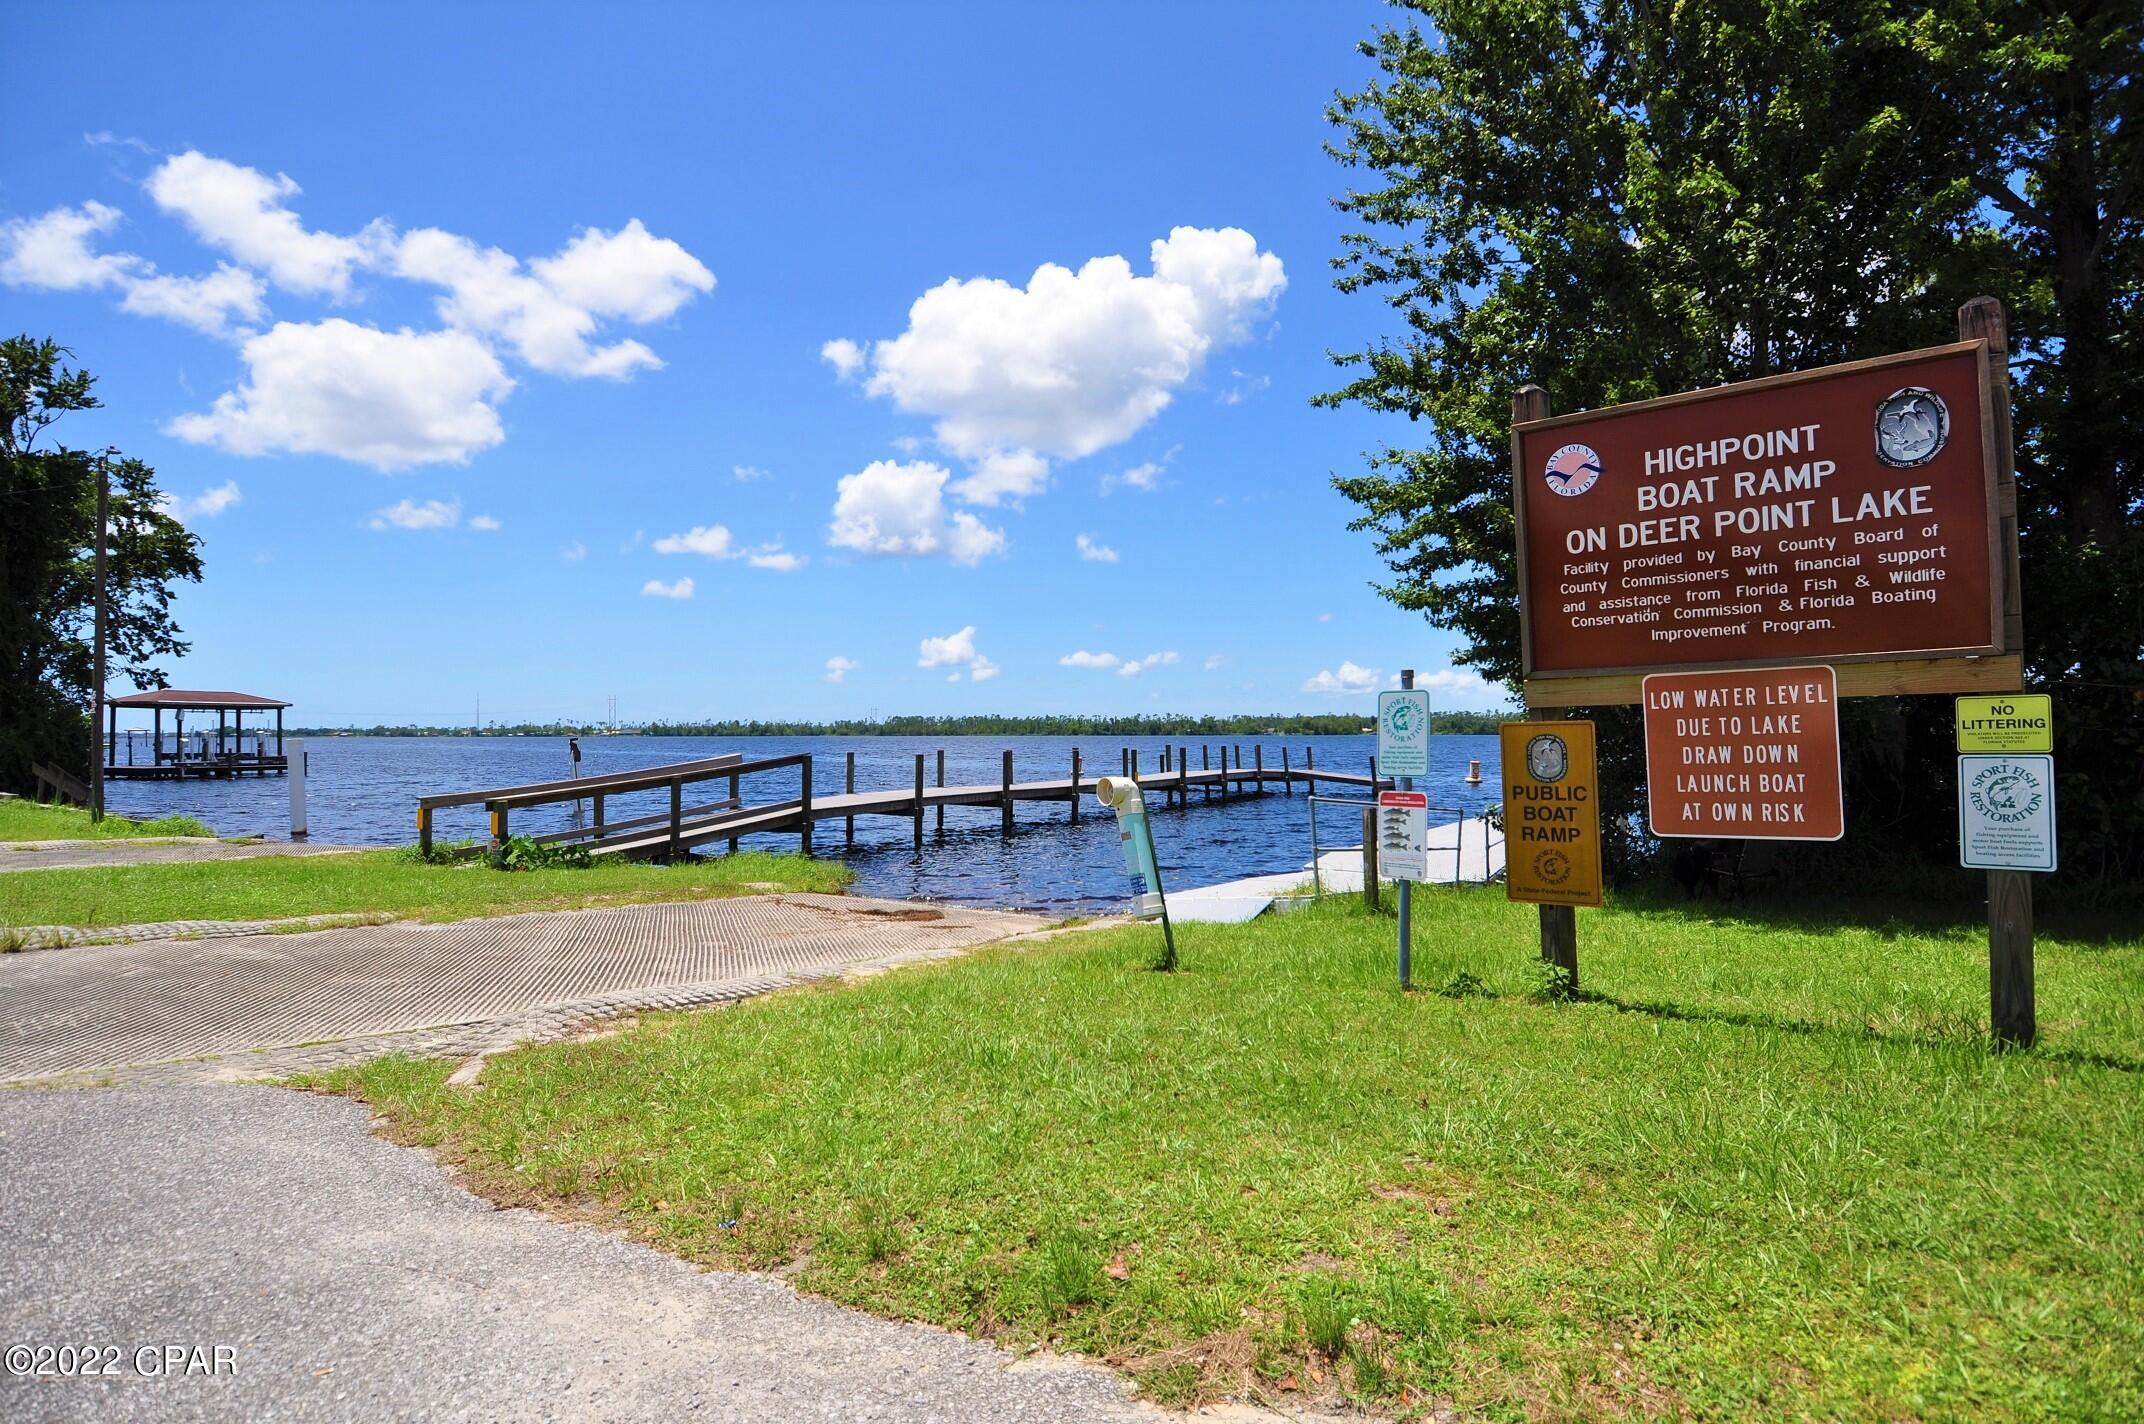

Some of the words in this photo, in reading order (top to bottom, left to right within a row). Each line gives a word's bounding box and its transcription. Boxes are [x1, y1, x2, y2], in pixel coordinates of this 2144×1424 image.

[1547, 455, 1559, 470] BAY
[1561, 445, 1597, 464] COUNTY
[1644, 424, 1821, 476] HIGHPOINT
[1548, 475, 1597, 496] FLORIDA
[1637, 476, 1720, 512] BOAT
[1734, 460, 1836, 499] RAMP
[1566, 527, 1606, 555] ON
[1618, 515, 1701, 549] DEER
[1714, 500, 1815, 537] POINT
[1831, 485, 1934, 524] LAKE
[1563, 562, 1609, 576] Facility
[1623, 552, 1683, 572] provided
[1697, 550, 1716, 564] by
[1731, 545, 1762, 559] Bay
[1778, 537, 1837, 553] County
[1854, 528, 1904, 545] Board
[1921, 523, 1939, 537] of
[1560, 580, 1608, 595] County
[1621, 568, 1729, 589] Commissioners
[1745, 563, 1778, 577] with
[1794, 554, 1860, 572] financial
[1877, 545, 1947, 566] support
[1562, 601, 1586, 613] and
[1599, 593, 1672, 610] assistance
[1686, 590, 1721, 602] from
[1736, 583, 1788, 597] Florida
[1804, 578, 1838, 592] Fish
[1855, 574, 1871, 588] &
[1888, 568, 1946, 585] Wildlife
[1571, 610, 1660, 628] Conservation
[1673, 601, 1762, 621] Commission
[1778, 599, 1793, 612] &
[1800, 594, 1855, 610] Florida
[1871, 588, 1937, 604] Boating
[1651, 622, 1747, 643] Improvement
[1762, 618, 1836, 635] Program.
[1384, 697, 1406, 716] SPORT
[1408, 698, 1424, 716] FISH
[1650, 690, 1684, 710] LOW
[1694, 687, 1756, 708] WATER
[1765, 683, 1828, 706] LEVEL
[1991, 705, 2015, 716] NO
[1382, 717, 1425, 742] RESTORATION
[1676, 717, 1711, 737] DUE
[1718, 716, 1742, 736] TO
[1751, 714, 1802, 735] LAKE
[1962, 718, 2046, 730] LITTERING
[1682, 745, 1732, 765] DRAW
[1743, 744, 1798, 764] DOWN
[1676, 774, 1750, 793] LAUNCH
[1759, 773, 1806, 793] BOAT
[1972, 764, 2009, 789] SPORT
[2012, 766, 2040, 789] FISH
[1512, 785, 1588, 802] PUBLIC
[1523, 806, 1577, 822] BOAT
[1682, 802, 1701, 821] AT
[1712, 802, 1753, 822] OWN
[1762, 803, 1805, 823] RISK
[1970, 791, 2042, 823] RESTORATION
[1522, 826, 1581, 843] RAMP
